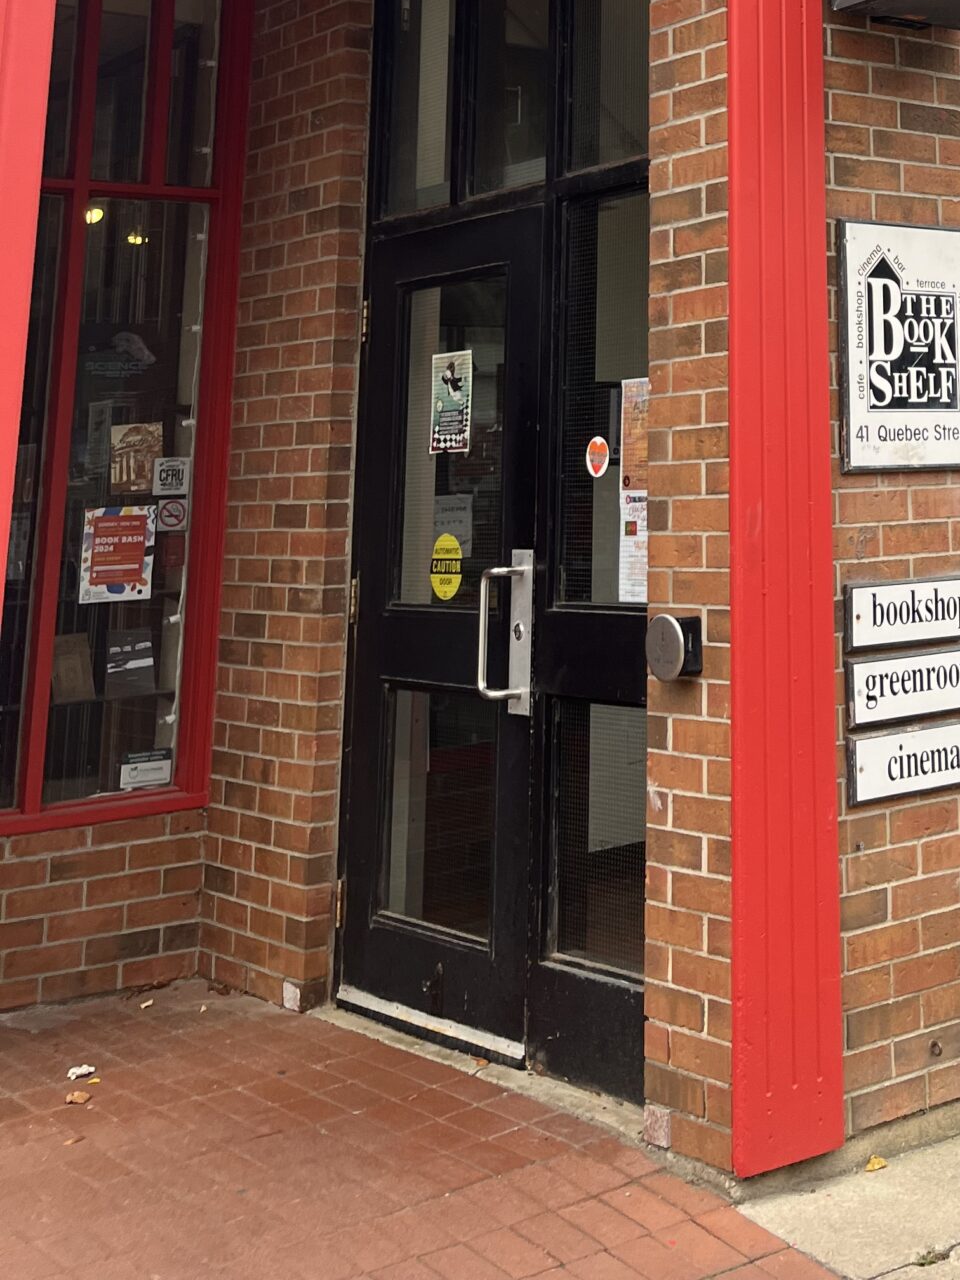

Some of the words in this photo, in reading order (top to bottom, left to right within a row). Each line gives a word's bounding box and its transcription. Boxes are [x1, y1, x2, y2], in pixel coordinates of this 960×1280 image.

[858, 243, 883, 277] cinema
[892, 255, 907, 274] bar
[916, 279, 947, 290] terrace
[902, 294, 954, 318] THE
[855, 290, 865, 349] bookshop
[858, 373, 866, 400] cafe
[869, 361, 957, 407] SHELF
[856, 425, 869, 443] 41
[878, 424, 929, 442] Quebec
[93, 545, 114, 553] 2024
[95, 536, 119, 544] BOOK
[122, 535, 144, 543] BASH
[434, 547, 460, 555] AUTOMATIC
[432, 560, 461, 573] CAUTION
[439, 577, 453, 586] DOOR
[887, 743, 960, 782] cinema
